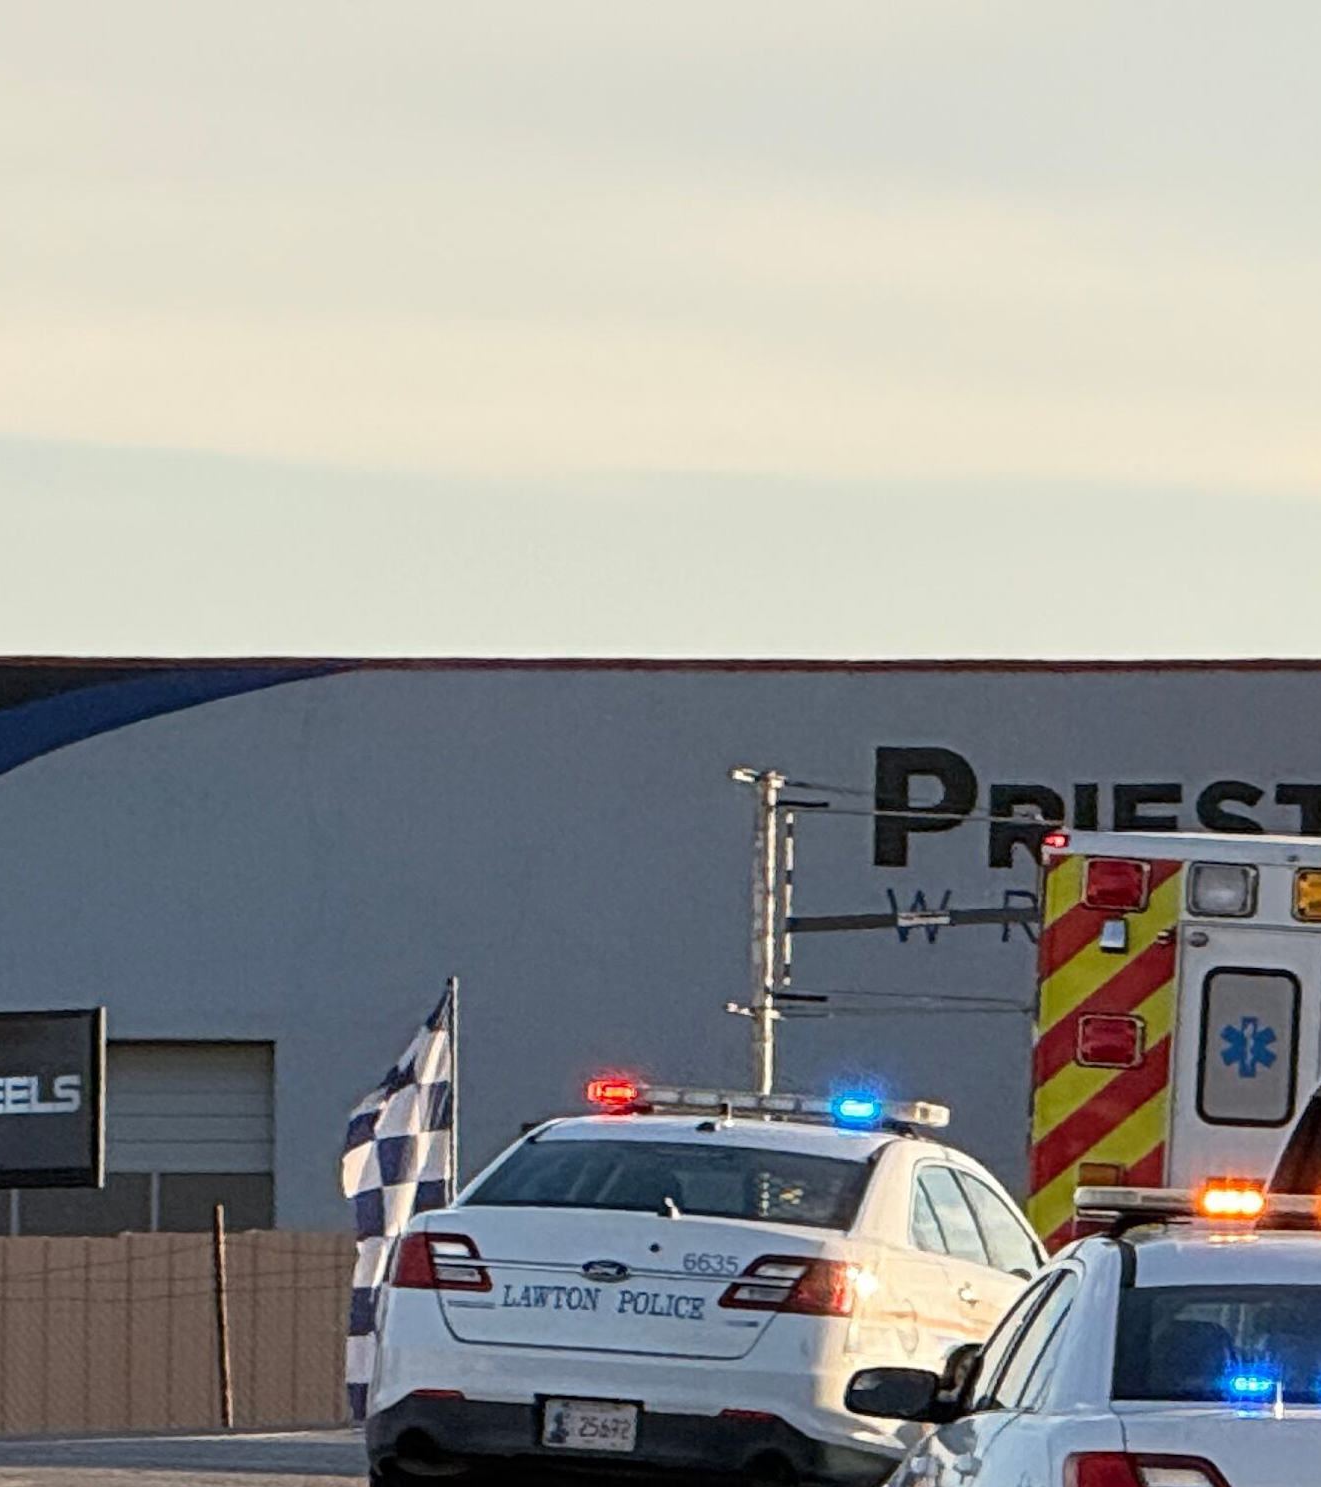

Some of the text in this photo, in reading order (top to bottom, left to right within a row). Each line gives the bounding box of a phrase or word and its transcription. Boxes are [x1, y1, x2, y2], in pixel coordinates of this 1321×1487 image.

[682, 1252, 740, 1275] 6635
[502, 1284, 706, 1320] LAWTON POLICE
